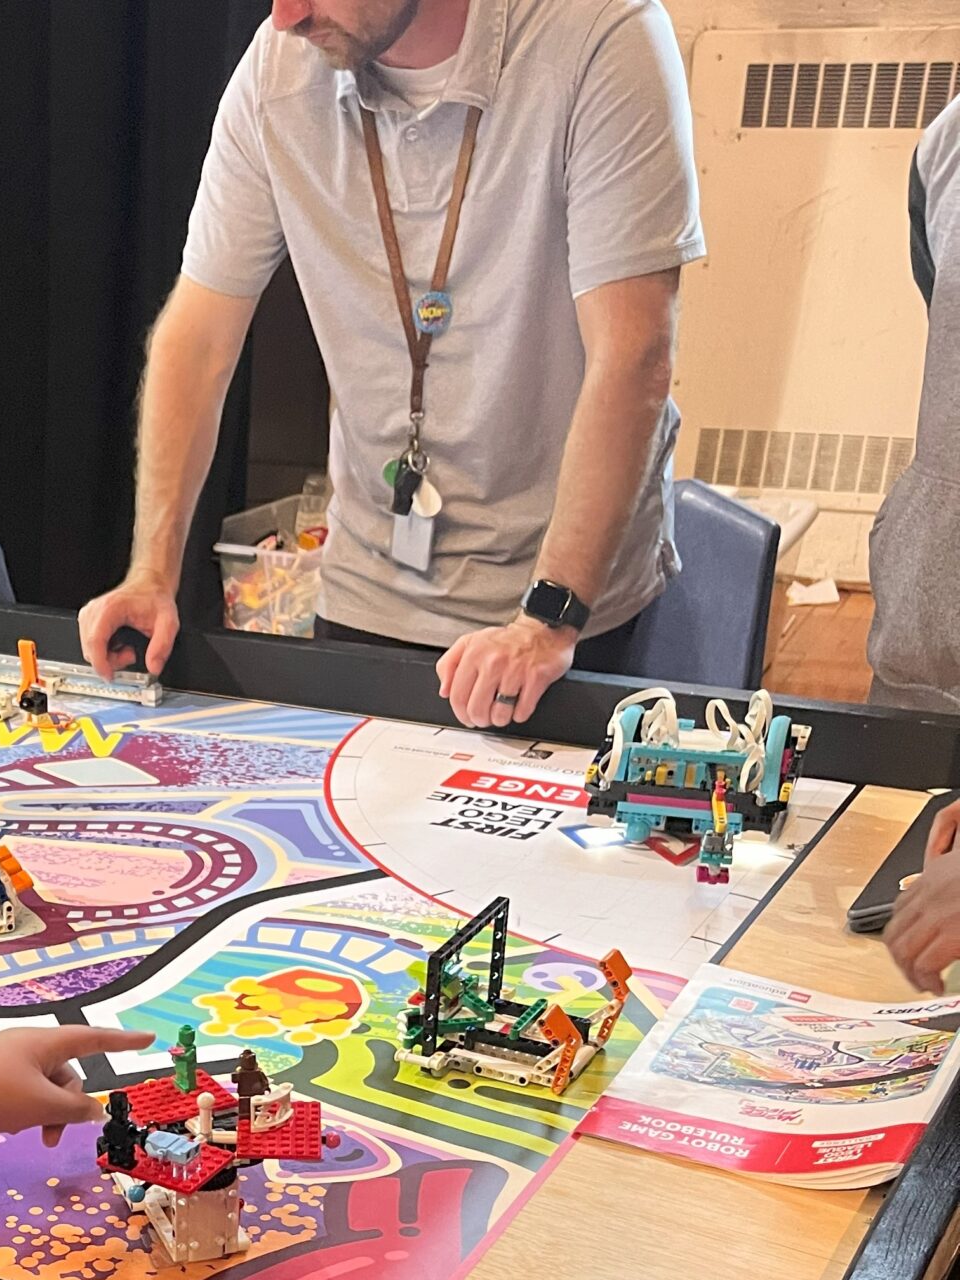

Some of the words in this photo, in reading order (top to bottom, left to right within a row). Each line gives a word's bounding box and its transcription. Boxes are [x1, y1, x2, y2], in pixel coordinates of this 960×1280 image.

[426, 791, 564, 819] LEAGUE
[429, 818, 540, 840] FIRST
[458, 808, 553, 830] LEGO
[872, 1007, 924, 1015] FIRST
[618, 1121, 675, 1141] GAME
[638, 1115, 745, 1146] RULEBOOK
[677, 1137, 750, 1159] ROBOT
[816, 1142, 873, 1154] LEAGUE
